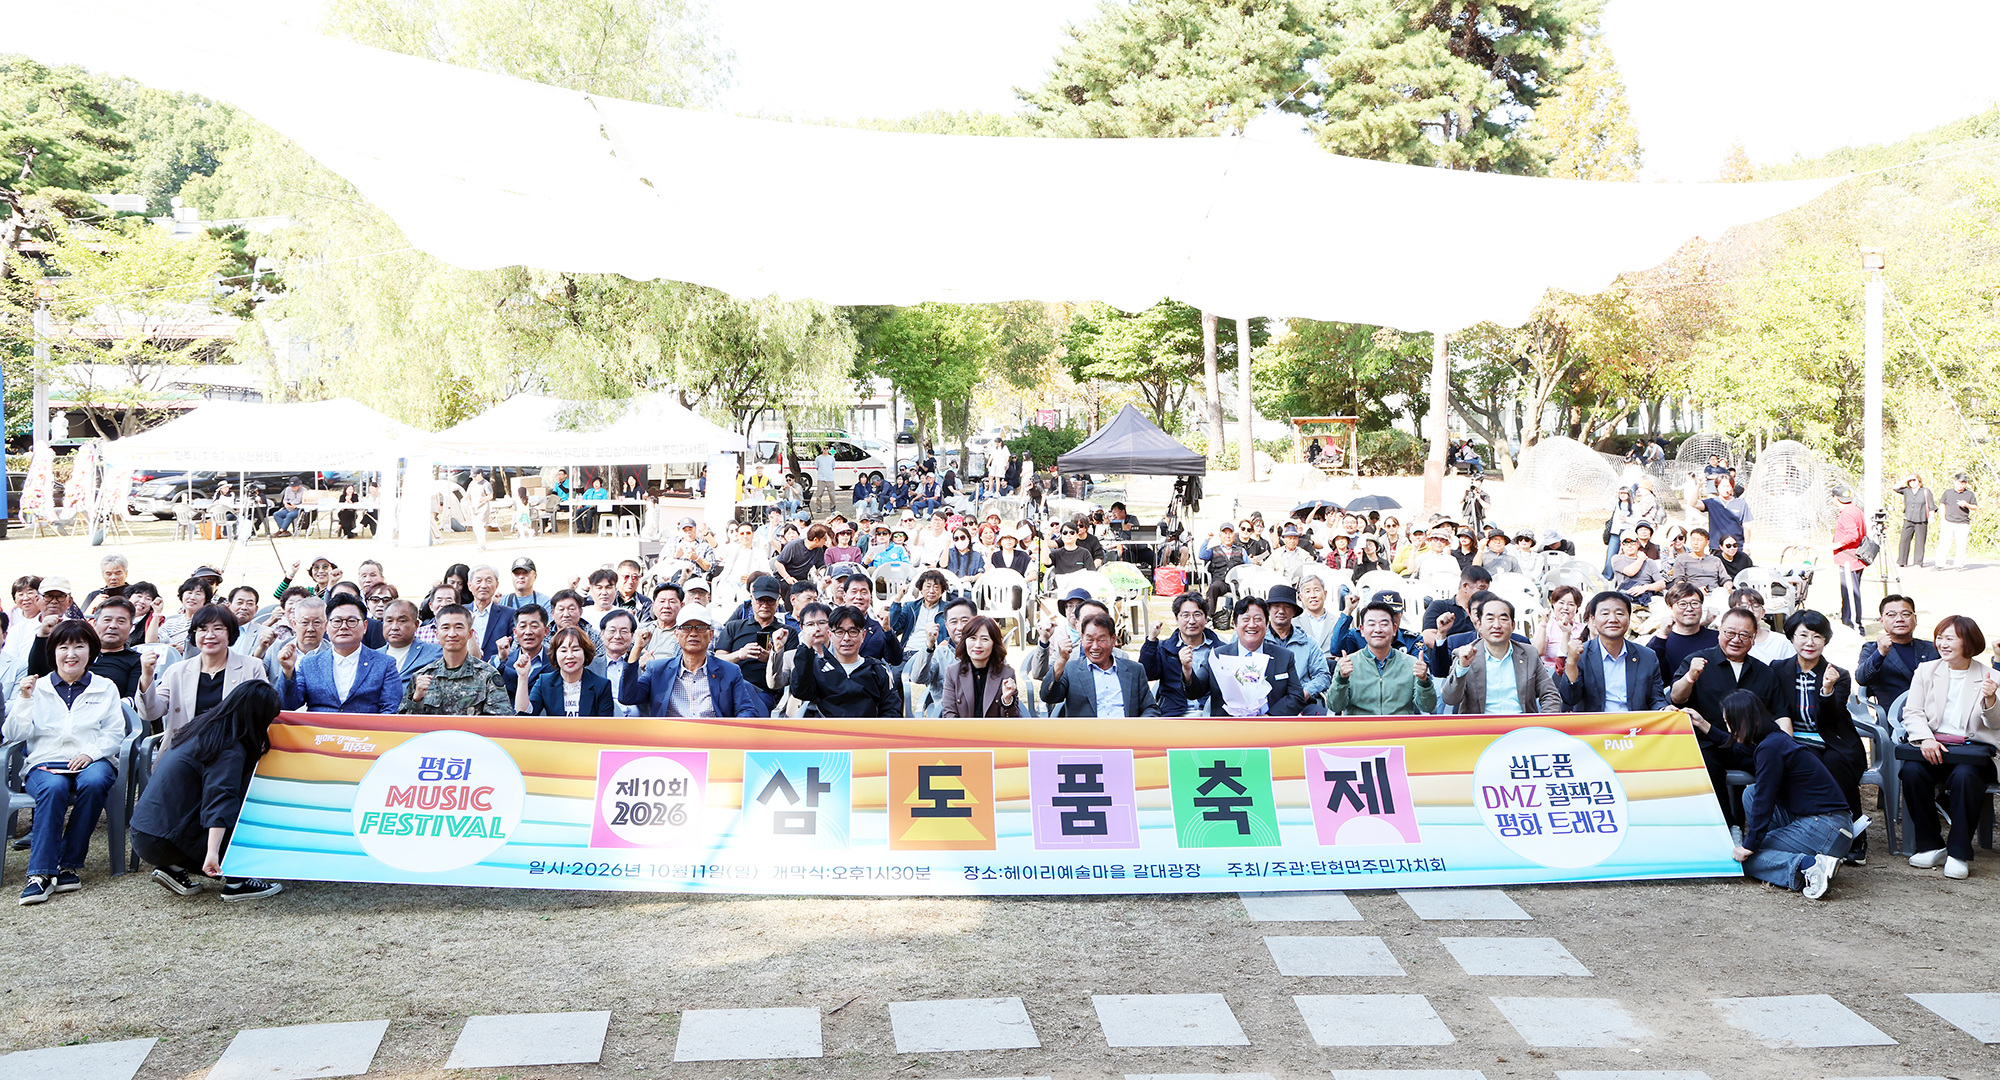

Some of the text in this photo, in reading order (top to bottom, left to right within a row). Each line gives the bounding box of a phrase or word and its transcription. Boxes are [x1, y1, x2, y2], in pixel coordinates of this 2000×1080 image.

[1603, 738, 1635, 752] PAJU
[418, 756, 472, 782] 평화
[1509, 753, 1574, 780] 삼도품
[385, 785, 495, 812] MUSIC
[615, 777, 688, 798] 제10회
[757, 757, 1396, 836] 삼 도 품 축 제
[1482, 781, 1616, 810] DMZ 철책길
[360, 812, 506, 839] FESTIVAL
[611, 801, 688, 827] 2026
[1495, 809, 1619, 837] 평화 트레킹
[529, 861, 641, 878] 일시:2026년
[772, 864, 931, 881] 개막식:오후1시30분
[963, 864, 1126, 881] 장소:헤이리예술마을
[1133, 863, 1202, 880] 갈대광장
[1227, 857, 1448, 879] 주최/주관:탄현면주민자치회
